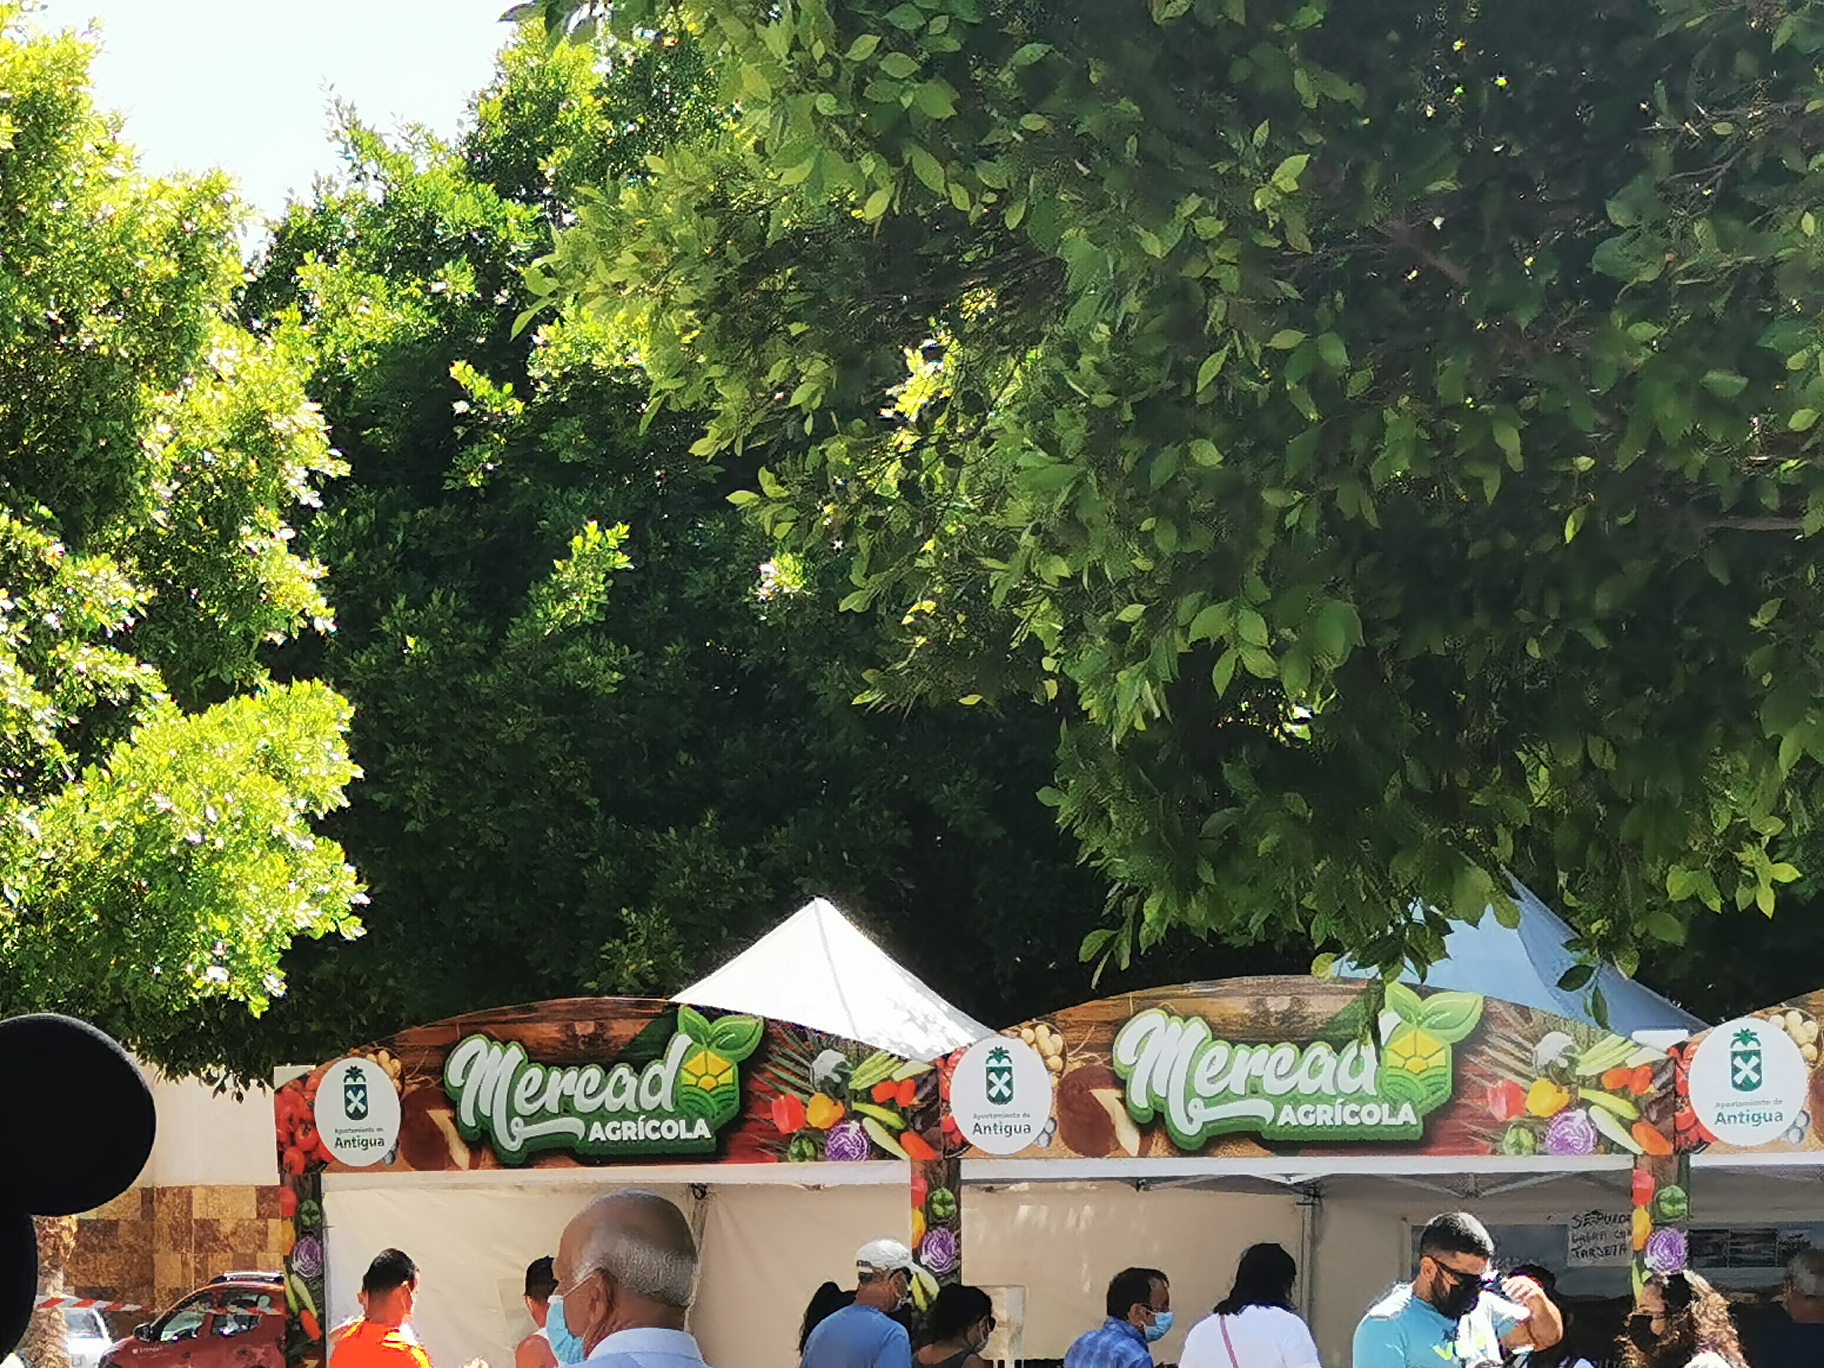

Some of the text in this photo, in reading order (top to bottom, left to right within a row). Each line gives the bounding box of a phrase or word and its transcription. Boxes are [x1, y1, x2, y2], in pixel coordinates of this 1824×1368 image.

[1277, 1098, 1418, 1127] AGRÍCOLA
[1714, 1109, 1784, 1127] Antigua
[588, 1115, 712, 1142] AGRÍCOLA
[972, 1121, 1032, 1138] Antigua
[334, 1134, 385, 1152] Antigua
